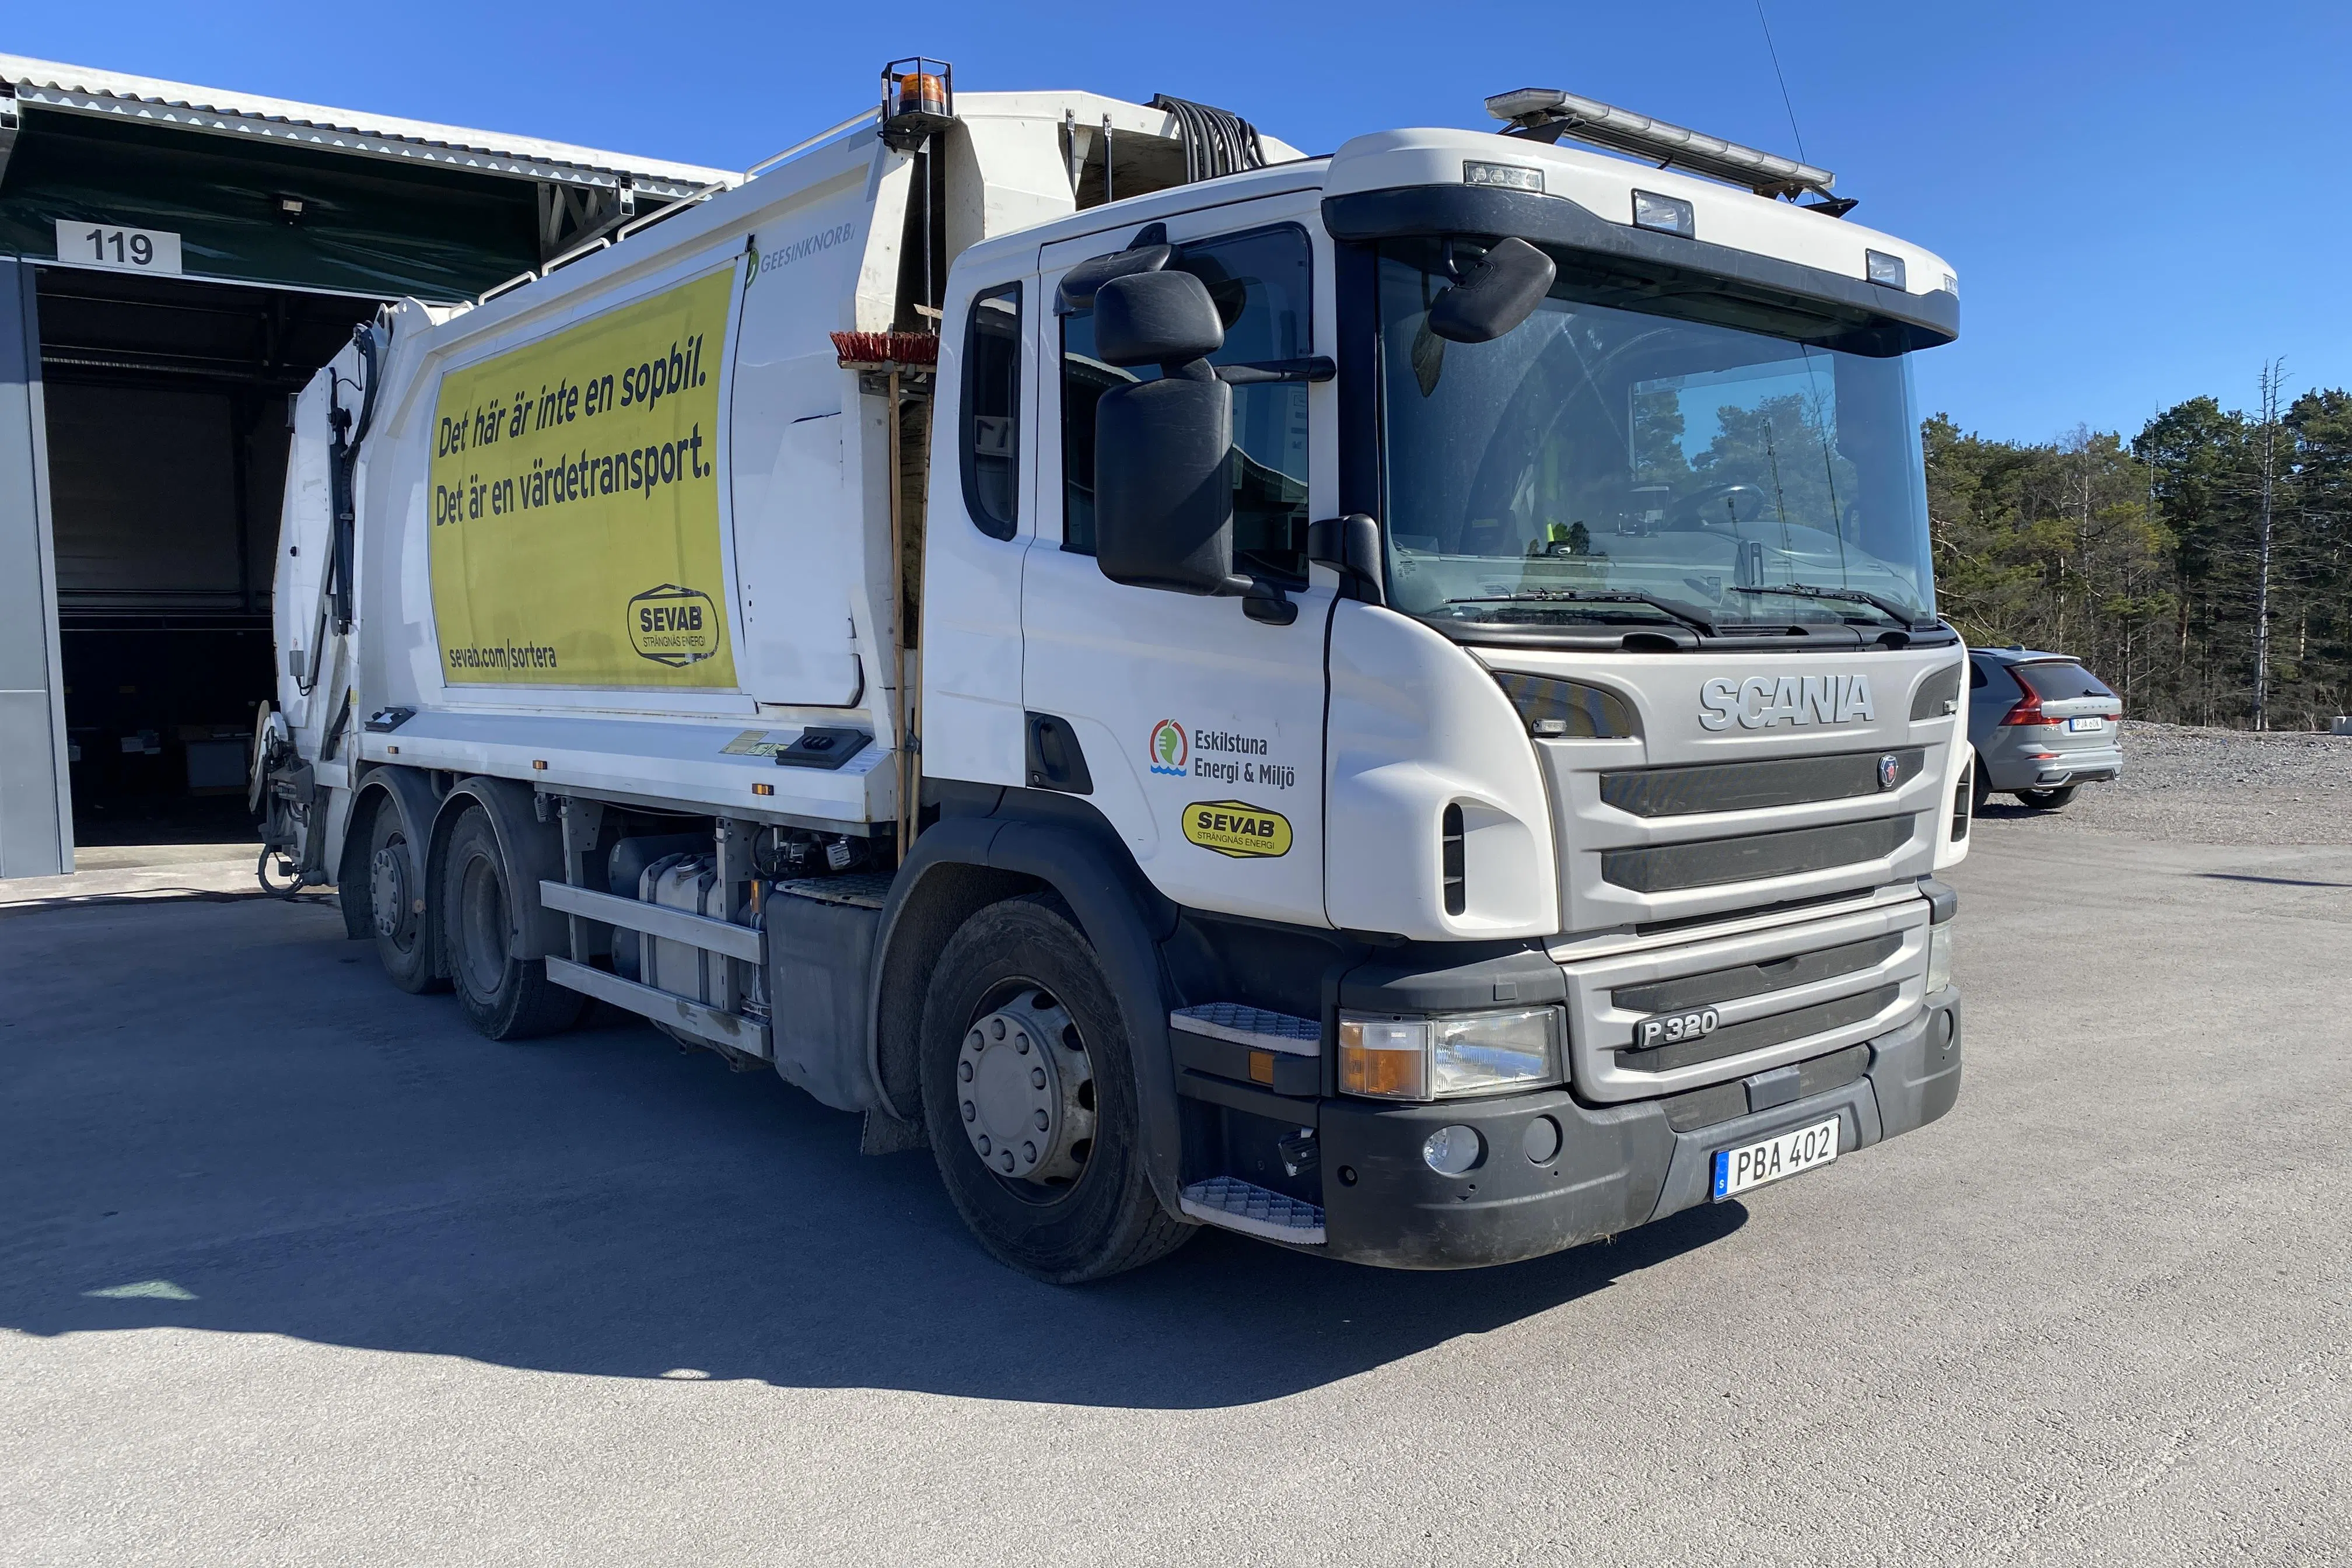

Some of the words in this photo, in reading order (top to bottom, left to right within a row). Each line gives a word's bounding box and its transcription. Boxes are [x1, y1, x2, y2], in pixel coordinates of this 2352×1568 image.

[86, 229, 153, 265] 119
[439, 410, 468, 458] Det
[473, 399, 506, 448] här
[509, 391, 533, 438] är
[536, 377, 578, 430] inte
[585, 374, 614, 416] en
[620, 332, 706, 412] sopbil.
[437, 478, 463, 526] Det
[469, 473, 487, 519] är
[492, 478, 514, 515] en
[520, 421, 710, 509] värdetransport.
[640, 606, 702, 632] SEVAB
[450, 638, 557, 670] sevab.com/sortera
[643, 635, 681, 647] STRÄNGNÄS
[681, 635, 706, 647] ENERGI
[1698, 675, 1875, 732] SCANIA
[1195, 730, 1267, 755] Eskilstuna
[1195, 758, 1239, 783] Energi
[1244, 763, 1254, 783] &
[1259, 764, 1294, 789] Miljö
[1197, 811, 1275, 838] SEVAB
[1197, 832, 1243, 845] STRÄNGNÄS
[1245, 838, 1275, 849] ENERGI
[1643, 1021, 1662, 1046] P
[1665, 1011, 1718, 1042] 320
[1737, 1142, 1782, 1186] PBA
[1789, 1126, 1831, 1167] 402
